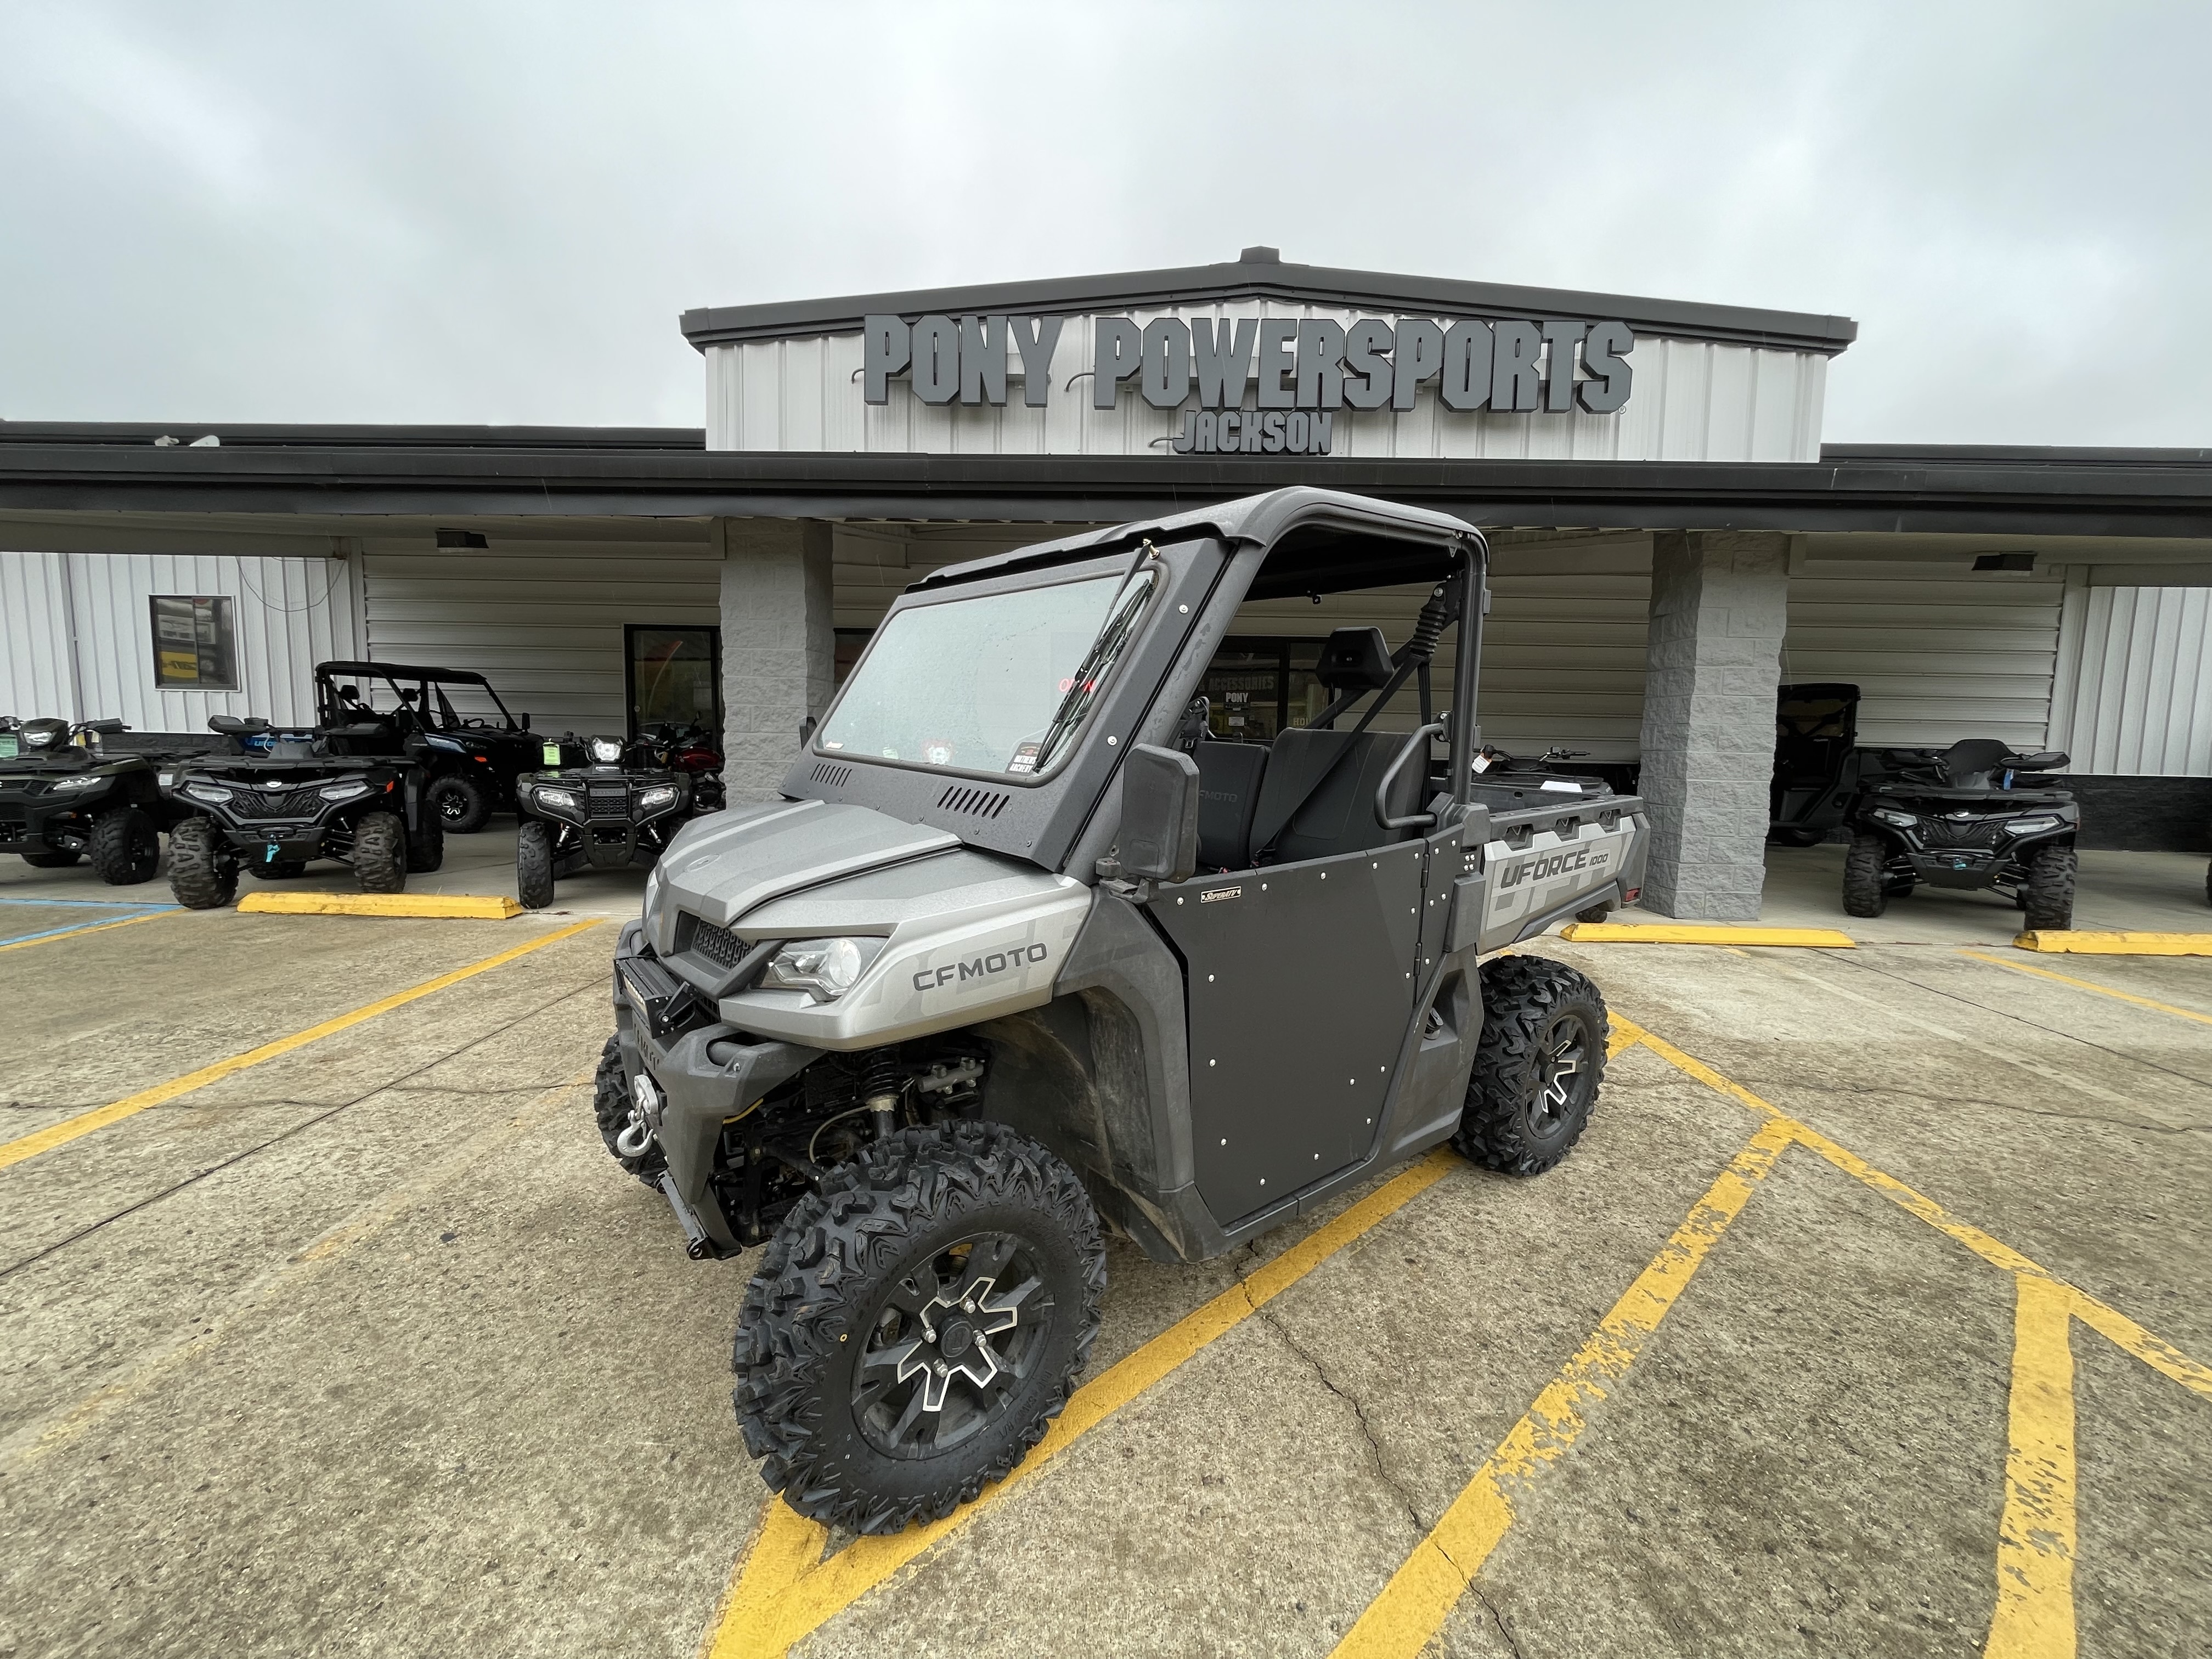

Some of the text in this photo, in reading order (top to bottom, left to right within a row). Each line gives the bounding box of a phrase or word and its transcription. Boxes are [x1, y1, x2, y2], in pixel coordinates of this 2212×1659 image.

[865, 314, 1634, 414] PONY POWERSPORTS
[1172, 410, 1331, 455] JACKSON
[1209, 675, 1274, 691] ACCESSORIES
[1225, 692, 1249, 703] PONY
[1500, 849, 1609, 889] UFORCE 1000
[913, 943, 1047, 991] CFMOTO
